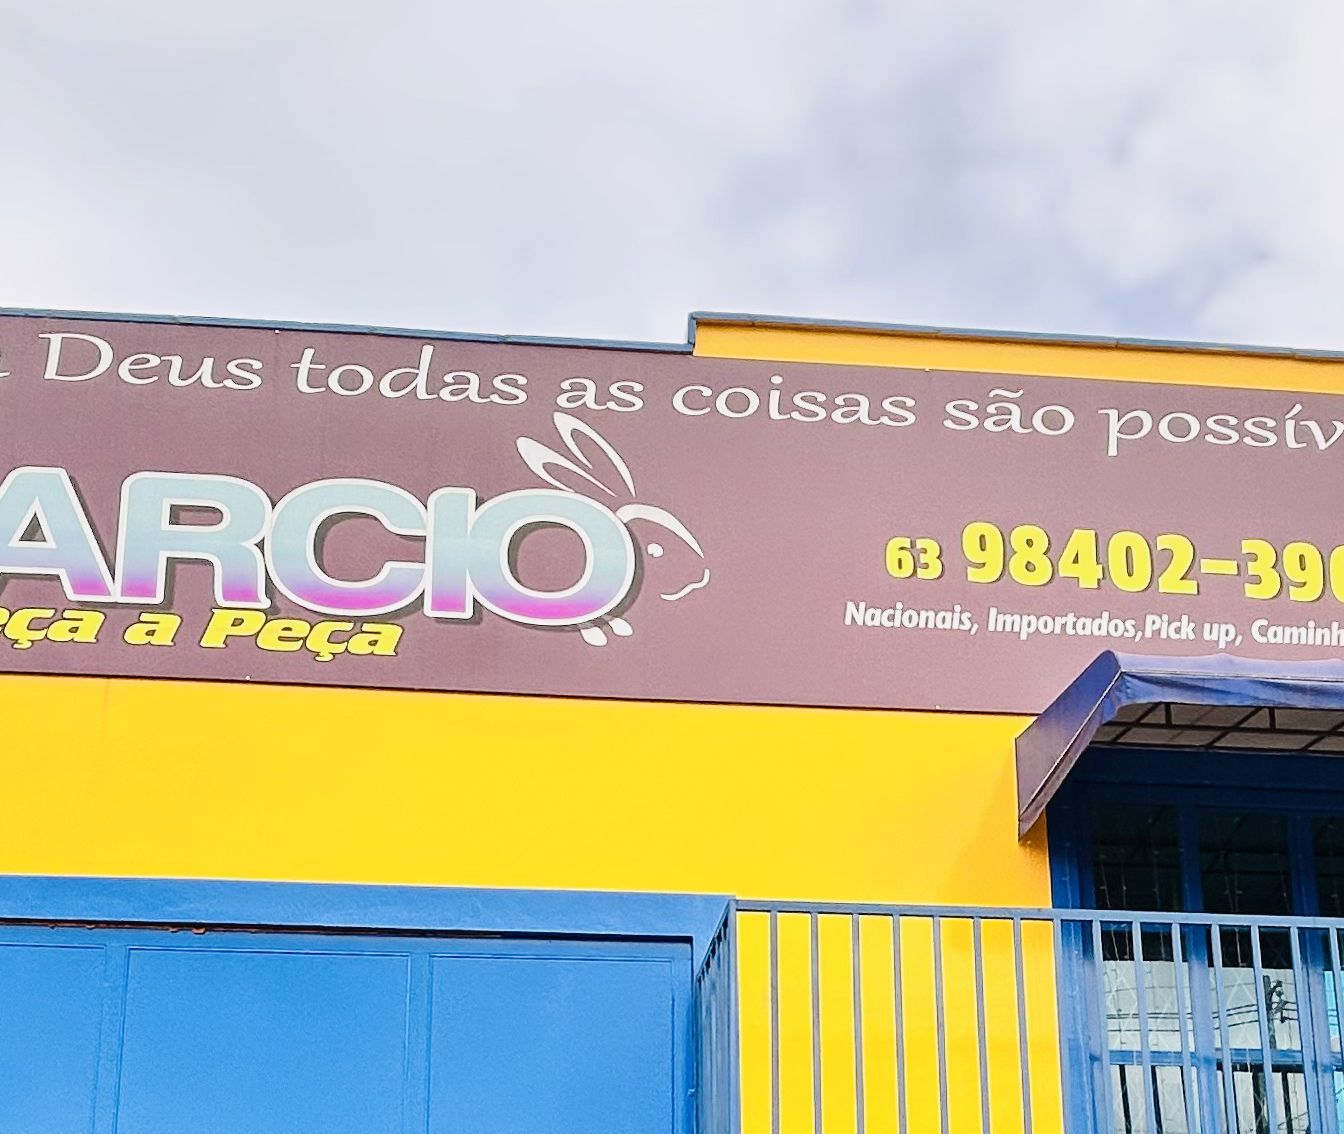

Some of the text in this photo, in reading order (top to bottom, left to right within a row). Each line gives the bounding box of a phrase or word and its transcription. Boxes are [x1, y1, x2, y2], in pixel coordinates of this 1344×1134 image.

[38, 333, 263, 390] Deus
[290, 344, 528, 405] todas
[553, 378, 644, 416] as
[672, 375, 916, 427] coisas
[943, 388, 1075, 435] são
[886, 538, 942, 580] 63
[124, 612, 181, 645] a
[199, 608, 403, 661] Peça
[843, 600, 980, 636] Nacionais,
[1202, 621, 1244, 649] up,
